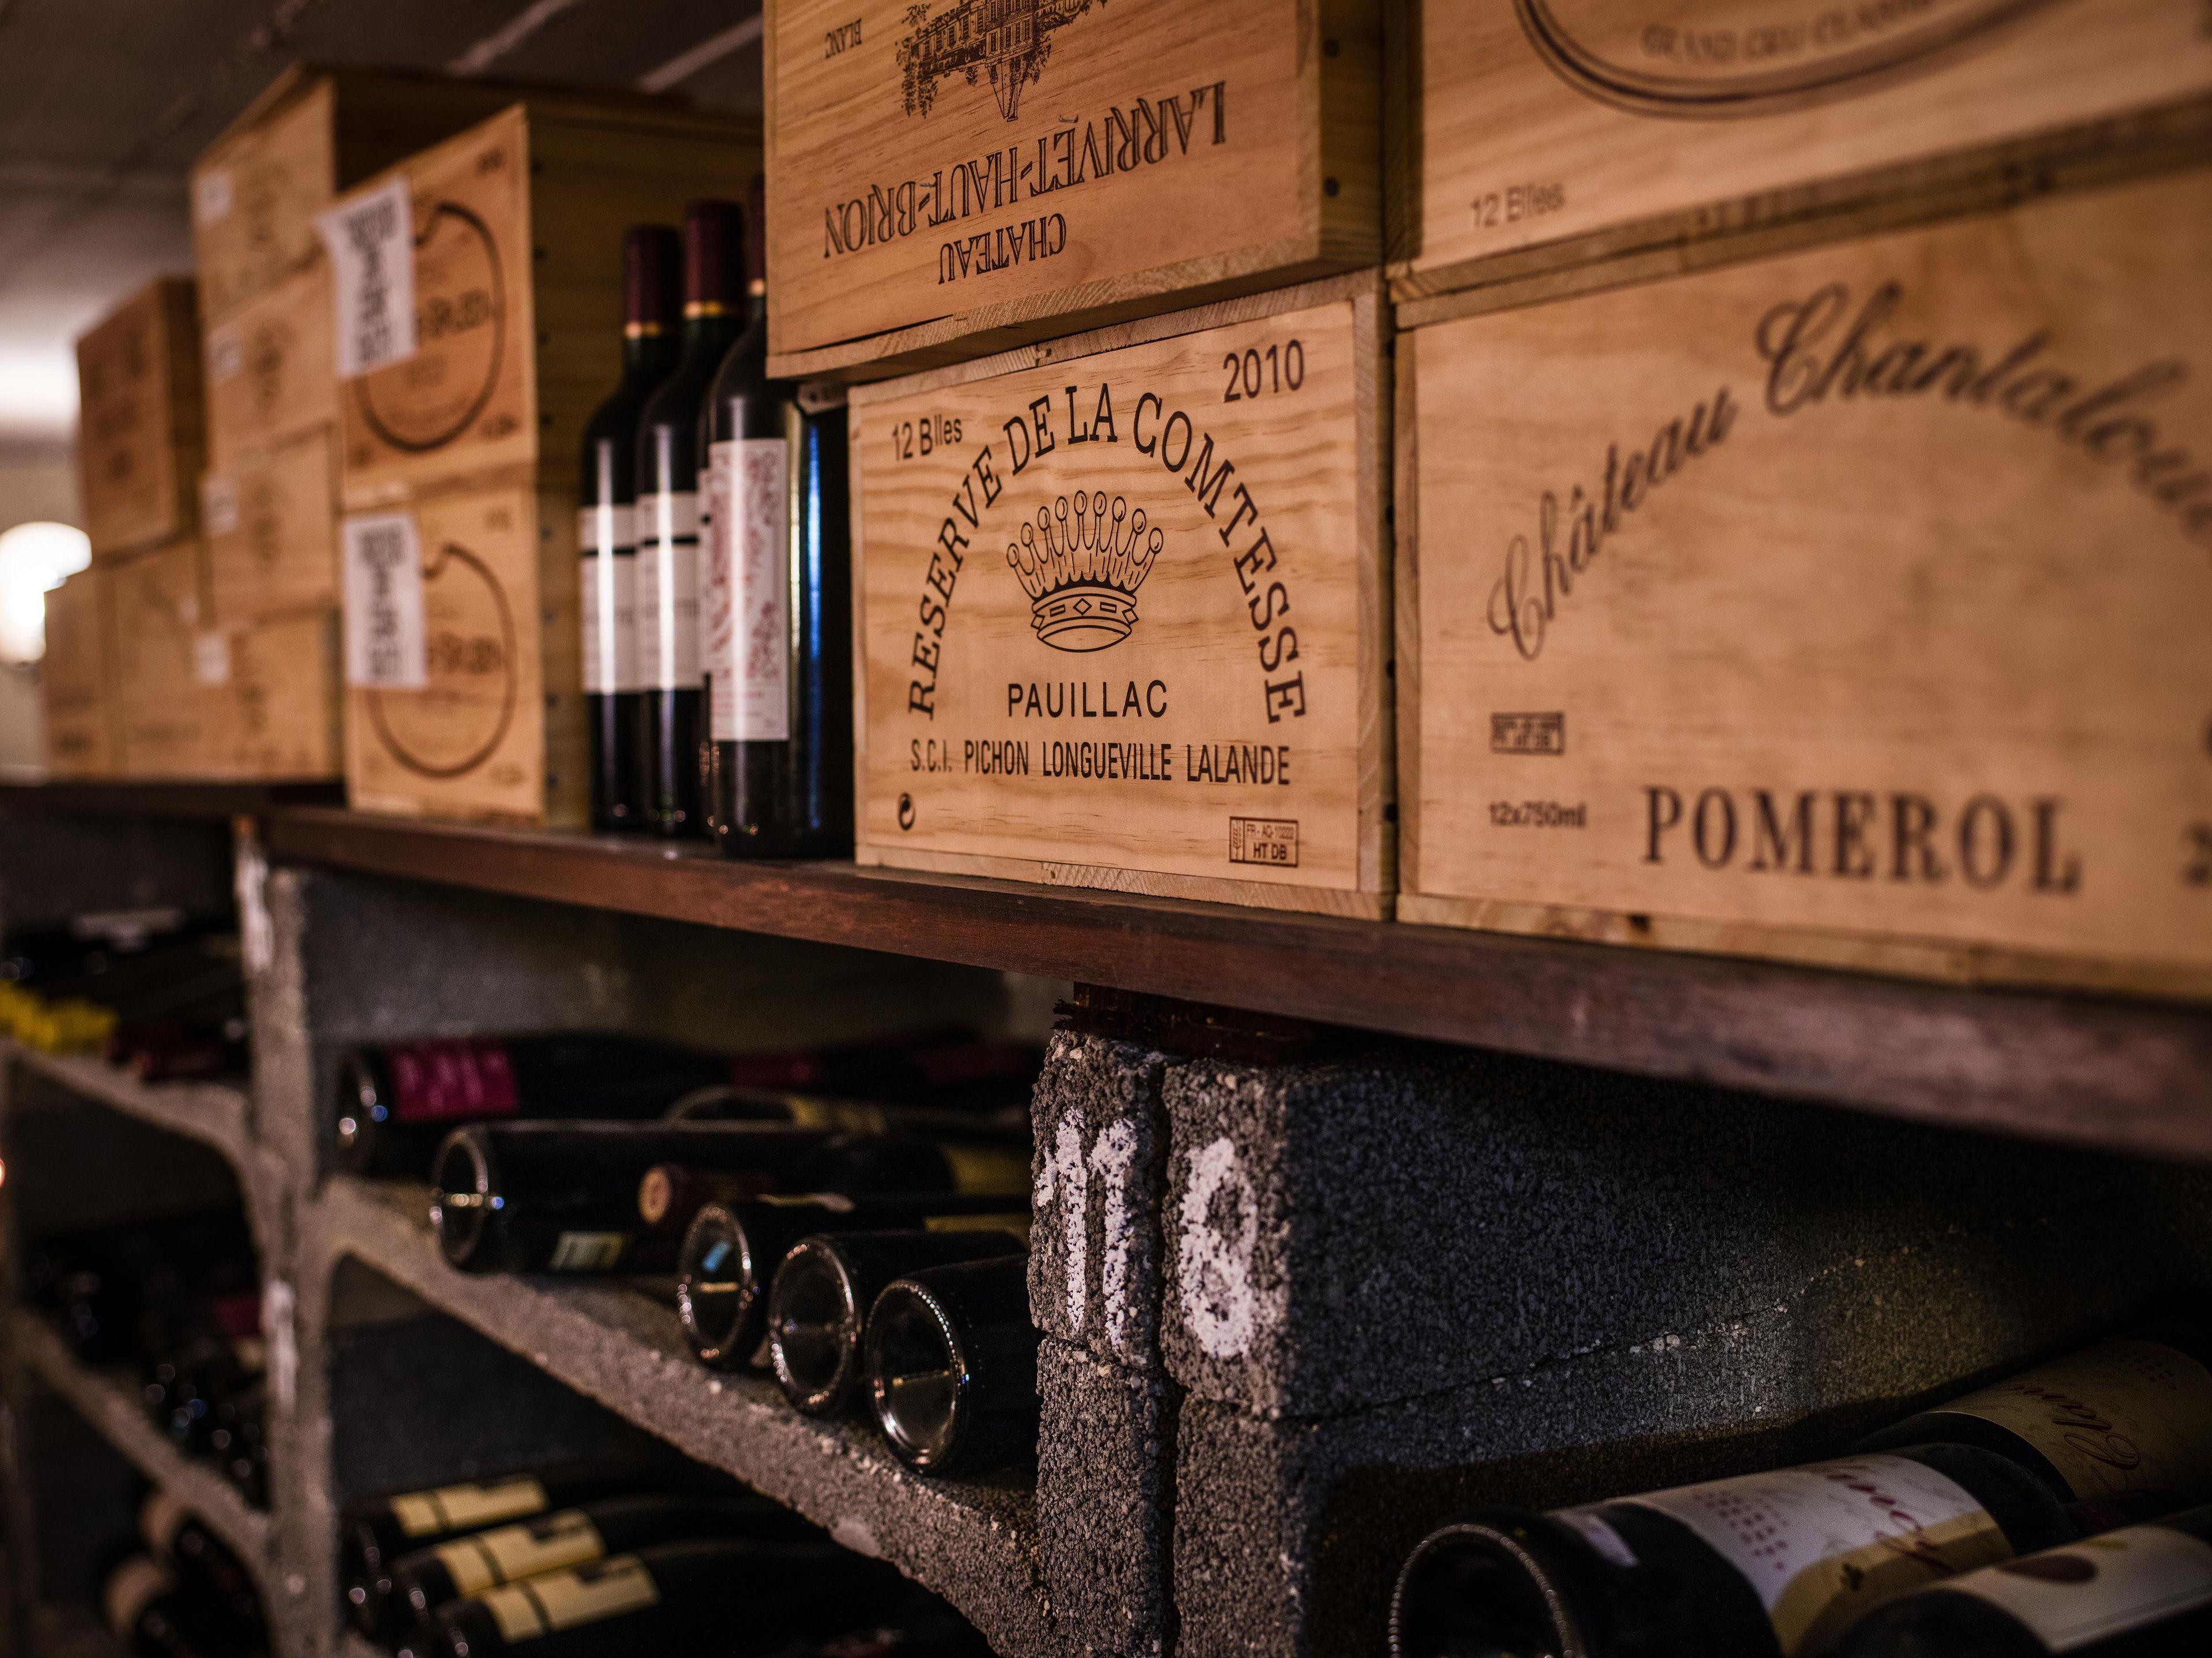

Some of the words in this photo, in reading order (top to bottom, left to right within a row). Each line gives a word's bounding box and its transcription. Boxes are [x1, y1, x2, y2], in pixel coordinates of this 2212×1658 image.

[824, 18, 862, 59] BLANC
[824, 80, 1226, 259] LARRIVET-HAUT-BRION
[1471, 192, 1498, 227] 12
[939, 212, 1067, 285] CHATEAU
[1223, 339, 1305, 403] 2010
[892, 421, 913, 461] 12
[1487, 385, 1739, 663] Château
[908, 445, 1003, 721] RESERVE
[1003, 395, 1055, 476] DE
[1065, 383, 1118, 445] LA
[1133, 392, 1306, 724] COMTESSE
[1008, 680, 1168, 718] PAUILLAC
[910, 739, 953, 773] S.C.I.
[964, 740, 1029, 775] PICHON
[1042, 741, 1172, 781] LONGUEVILLE
[1187, 744, 1290, 786] LALANDE
[1490, 800, 1587, 830] 12x750ml
[1641, 785, 2082, 895] POMEROL
